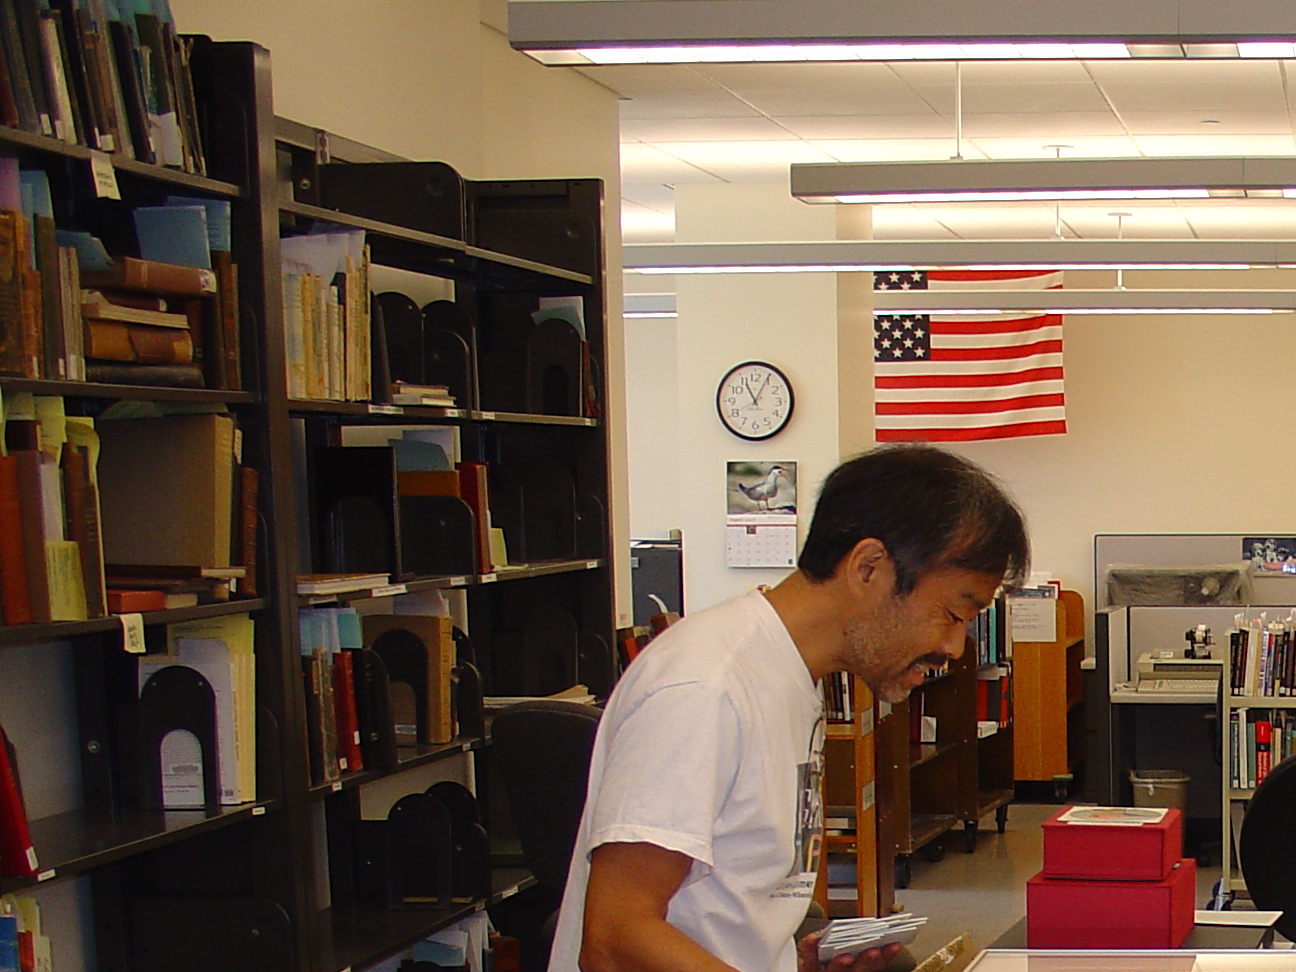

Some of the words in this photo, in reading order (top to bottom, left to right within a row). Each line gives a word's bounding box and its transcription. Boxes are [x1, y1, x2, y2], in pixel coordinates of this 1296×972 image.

[750, 373, 761, 383] 12
[731, 385, 744, 395] 10
[771, 385, 779, 395] 2
[728, 397, 736, 406] 9
[775, 397, 783, 406] 3
[731, 408, 740, 417] 8
[772, 409, 780, 418] 4
[741, 416, 748, 425] 7
[751, 420, 760, 430] 6
[763, 417, 771, 426] 5
